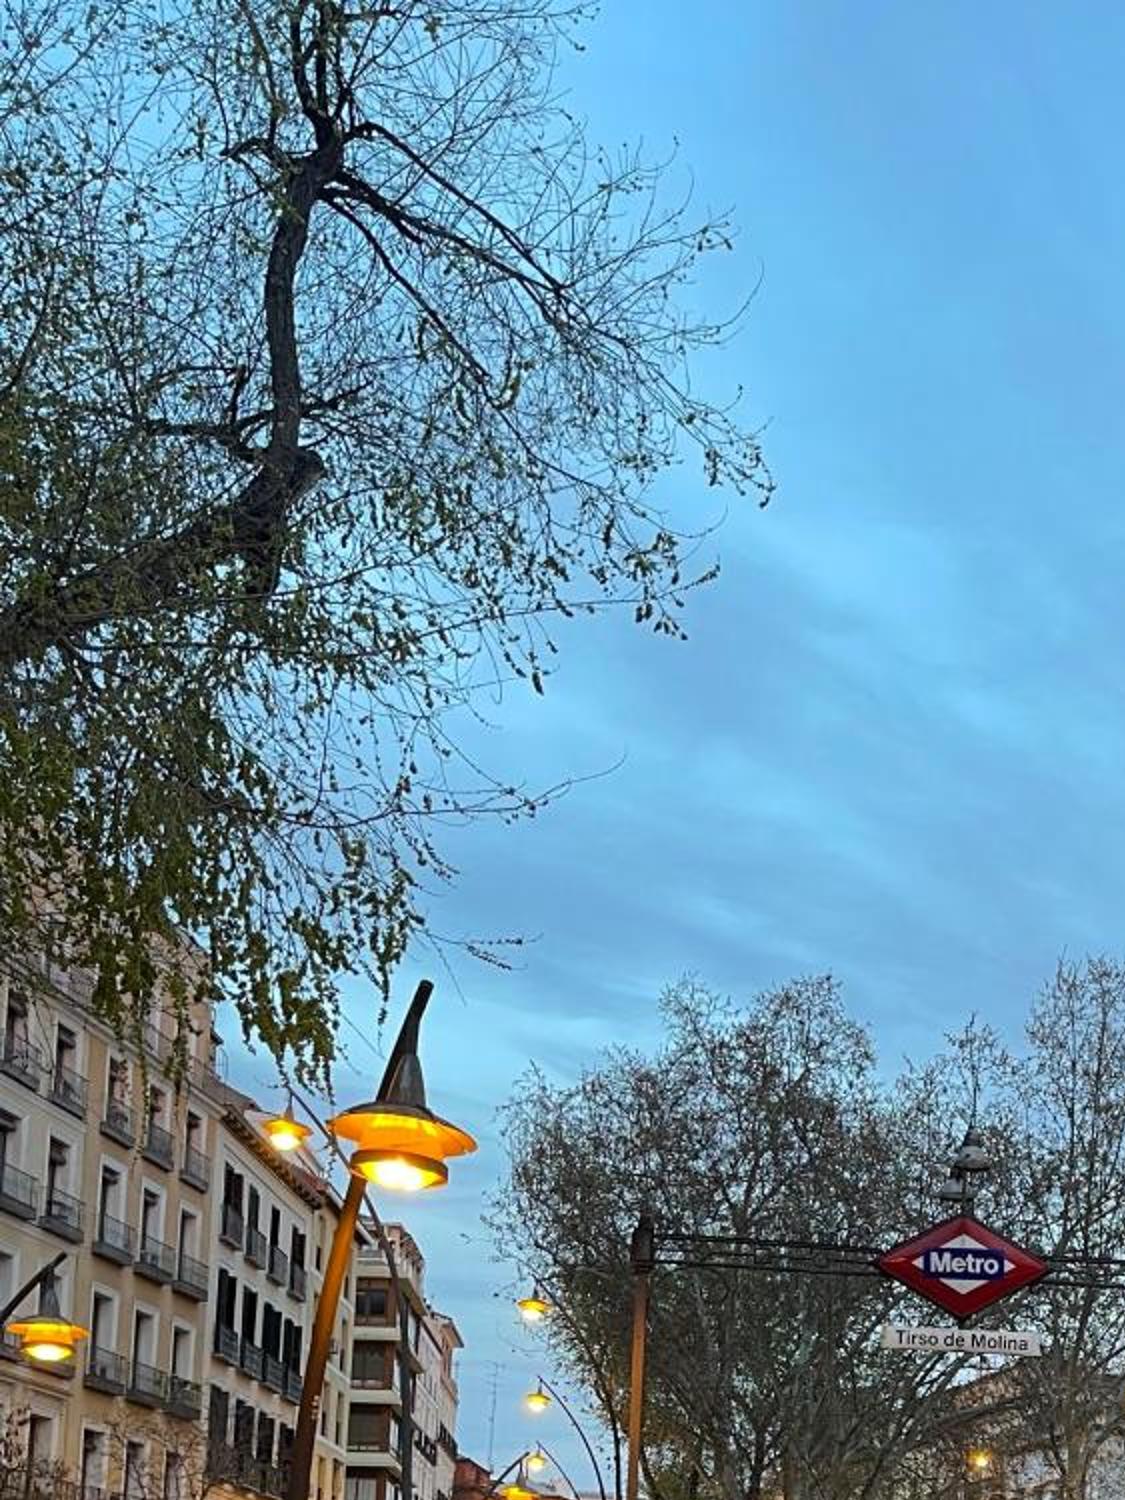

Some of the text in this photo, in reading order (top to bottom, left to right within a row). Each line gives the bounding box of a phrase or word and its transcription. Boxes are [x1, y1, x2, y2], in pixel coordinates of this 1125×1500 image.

[928, 1251, 999, 1275] Metro
[895, 1329, 1029, 1351] Tirso de Molina
